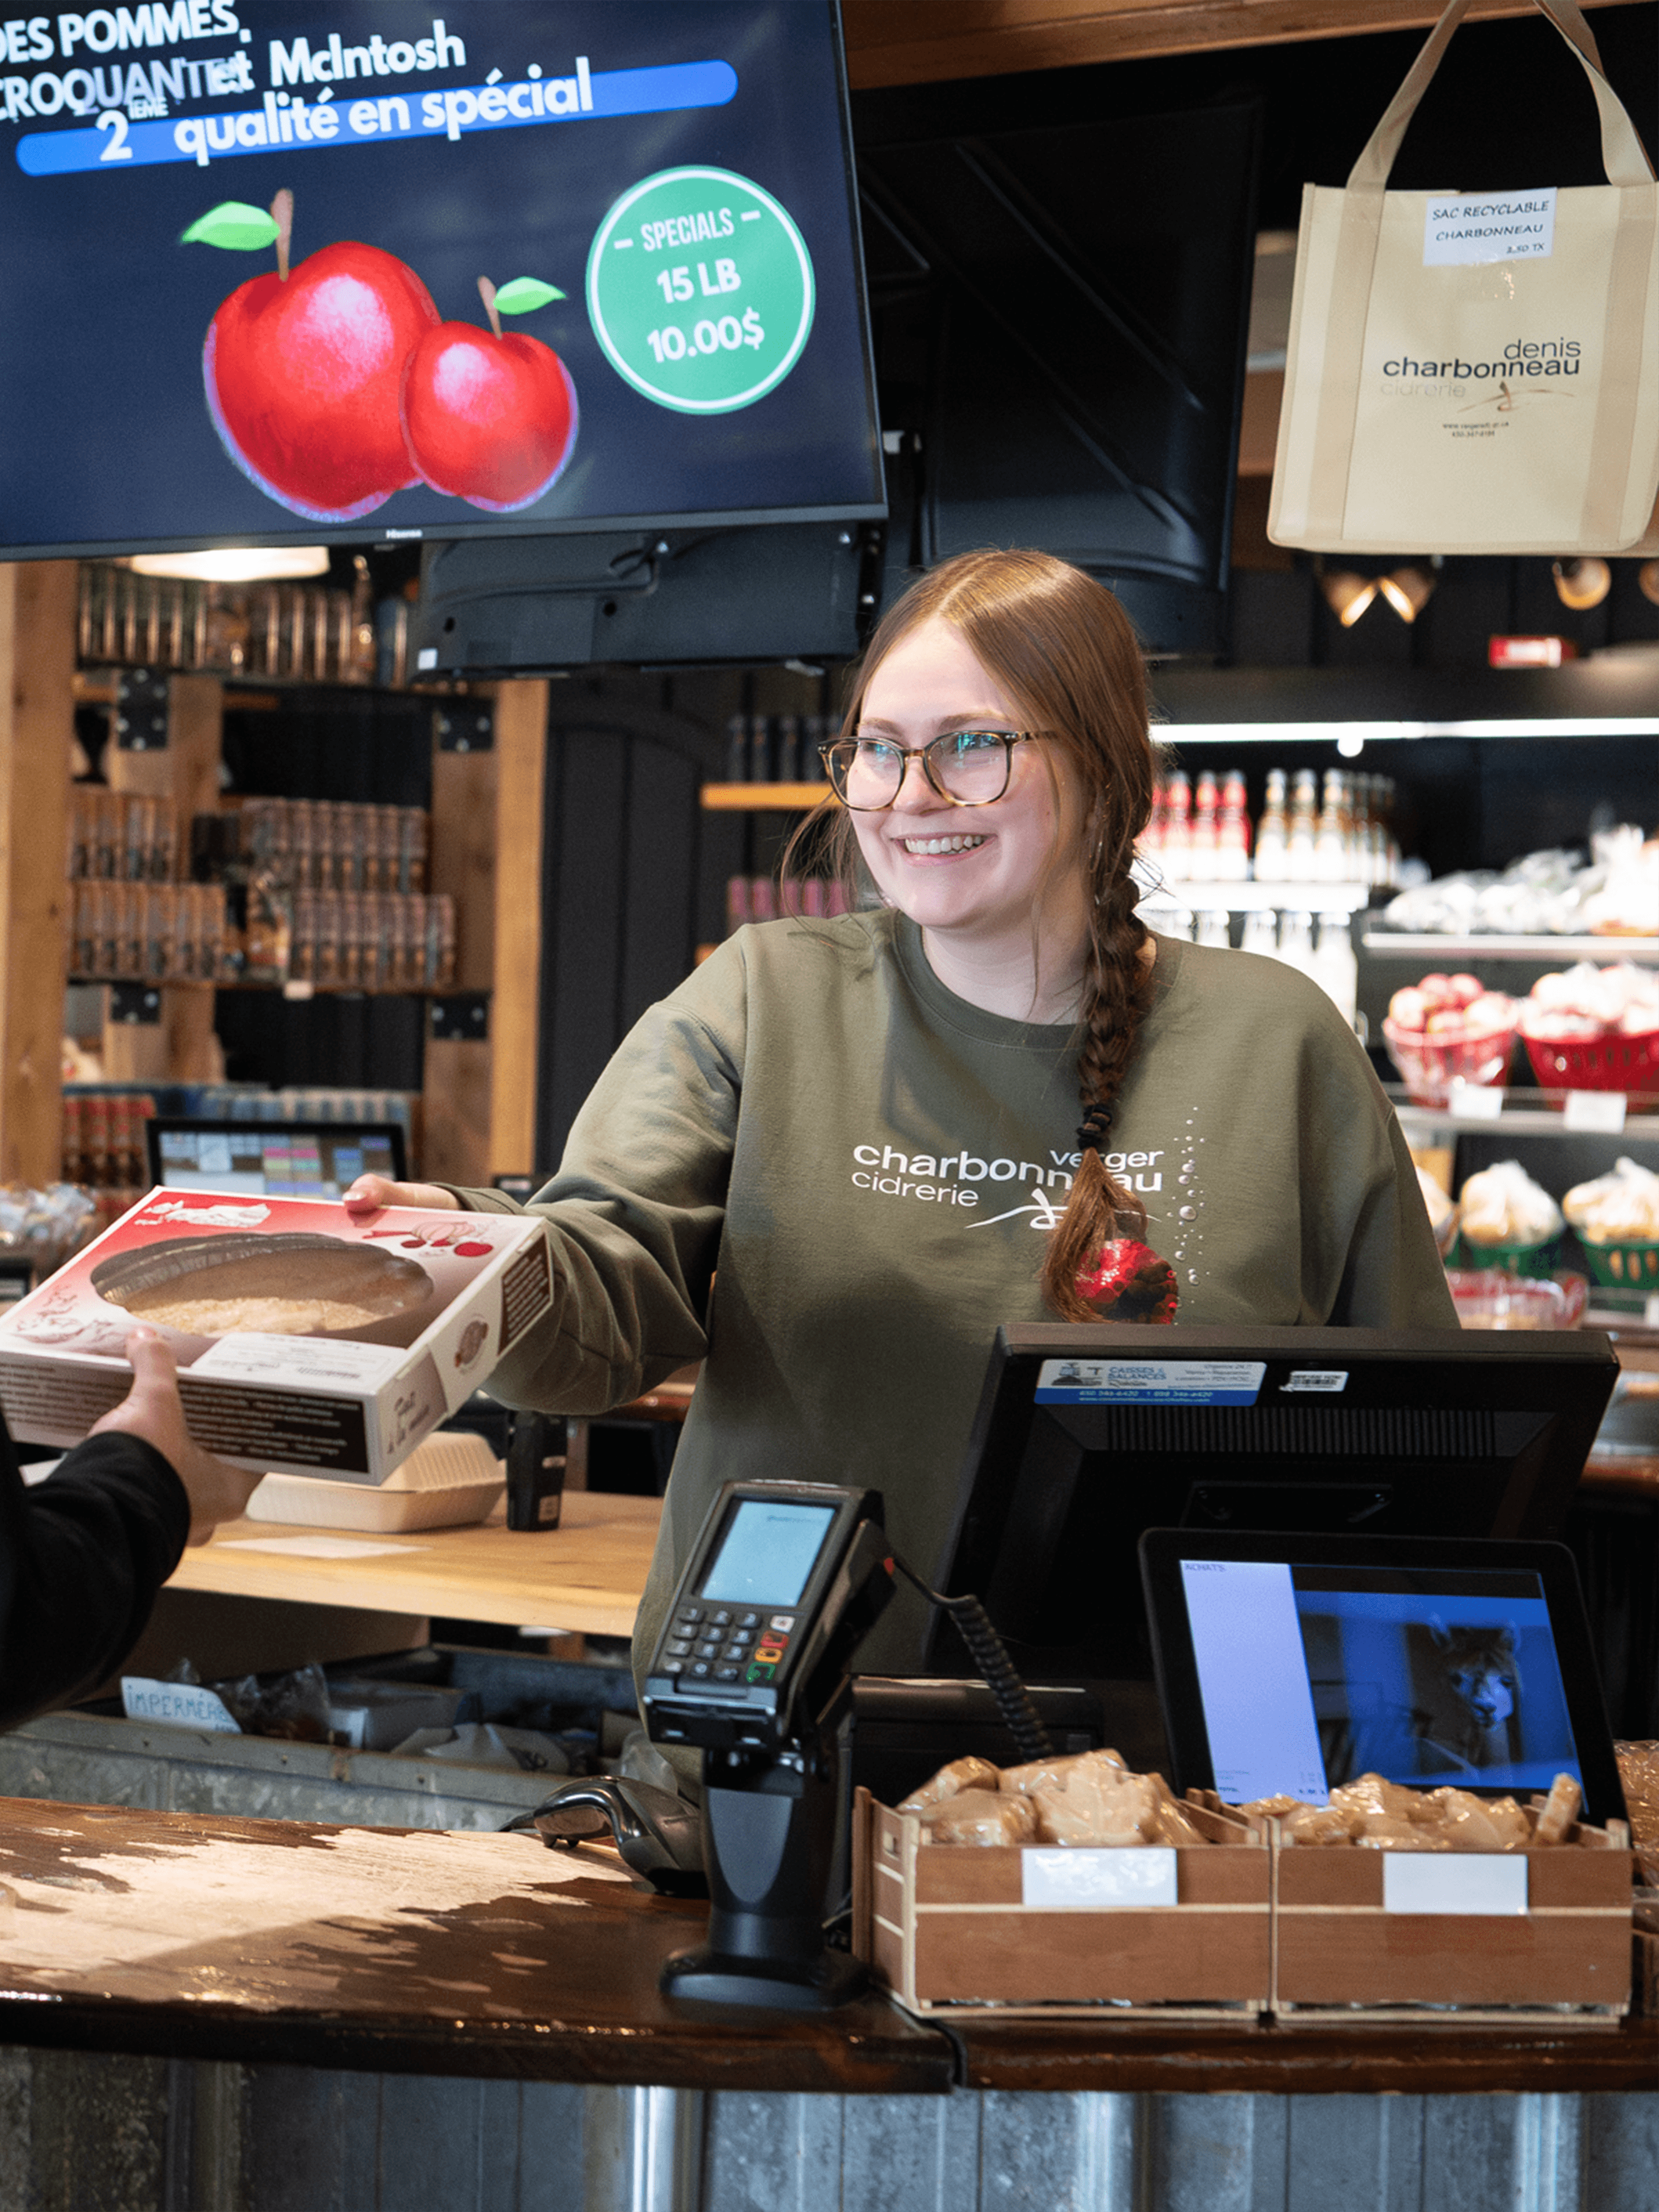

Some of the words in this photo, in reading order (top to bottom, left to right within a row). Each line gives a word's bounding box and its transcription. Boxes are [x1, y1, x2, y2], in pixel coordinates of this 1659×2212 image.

[0, 17, 54, 64] ES
[270, 19, 466, 87] McIntosh
[174, 86, 338, 166] qualité
[349, 96, 411, 137] en
[422, 55, 593, 140] spécial
[640, 207, 735, 252] SPECIALS
[1432, 206, 1460, 221] SAC
[1463, 200, 1550, 218] RECYCLABLE
[1435, 223, 1544, 242] CHARBONNEAU
[657, 261, 695, 304] 15
[697, 258, 742, 296] LB
[646, 306, 765, 363] 10.00$
[1503, 336, 1582, 360] denis
[1383, 357, 1580, 379] charbonneau
[853, 1144, 1162, 1191] charbonnau
[1049, 1148, 1165, 1172] veger
[851, 1171, 979, 1207] cidrerie
